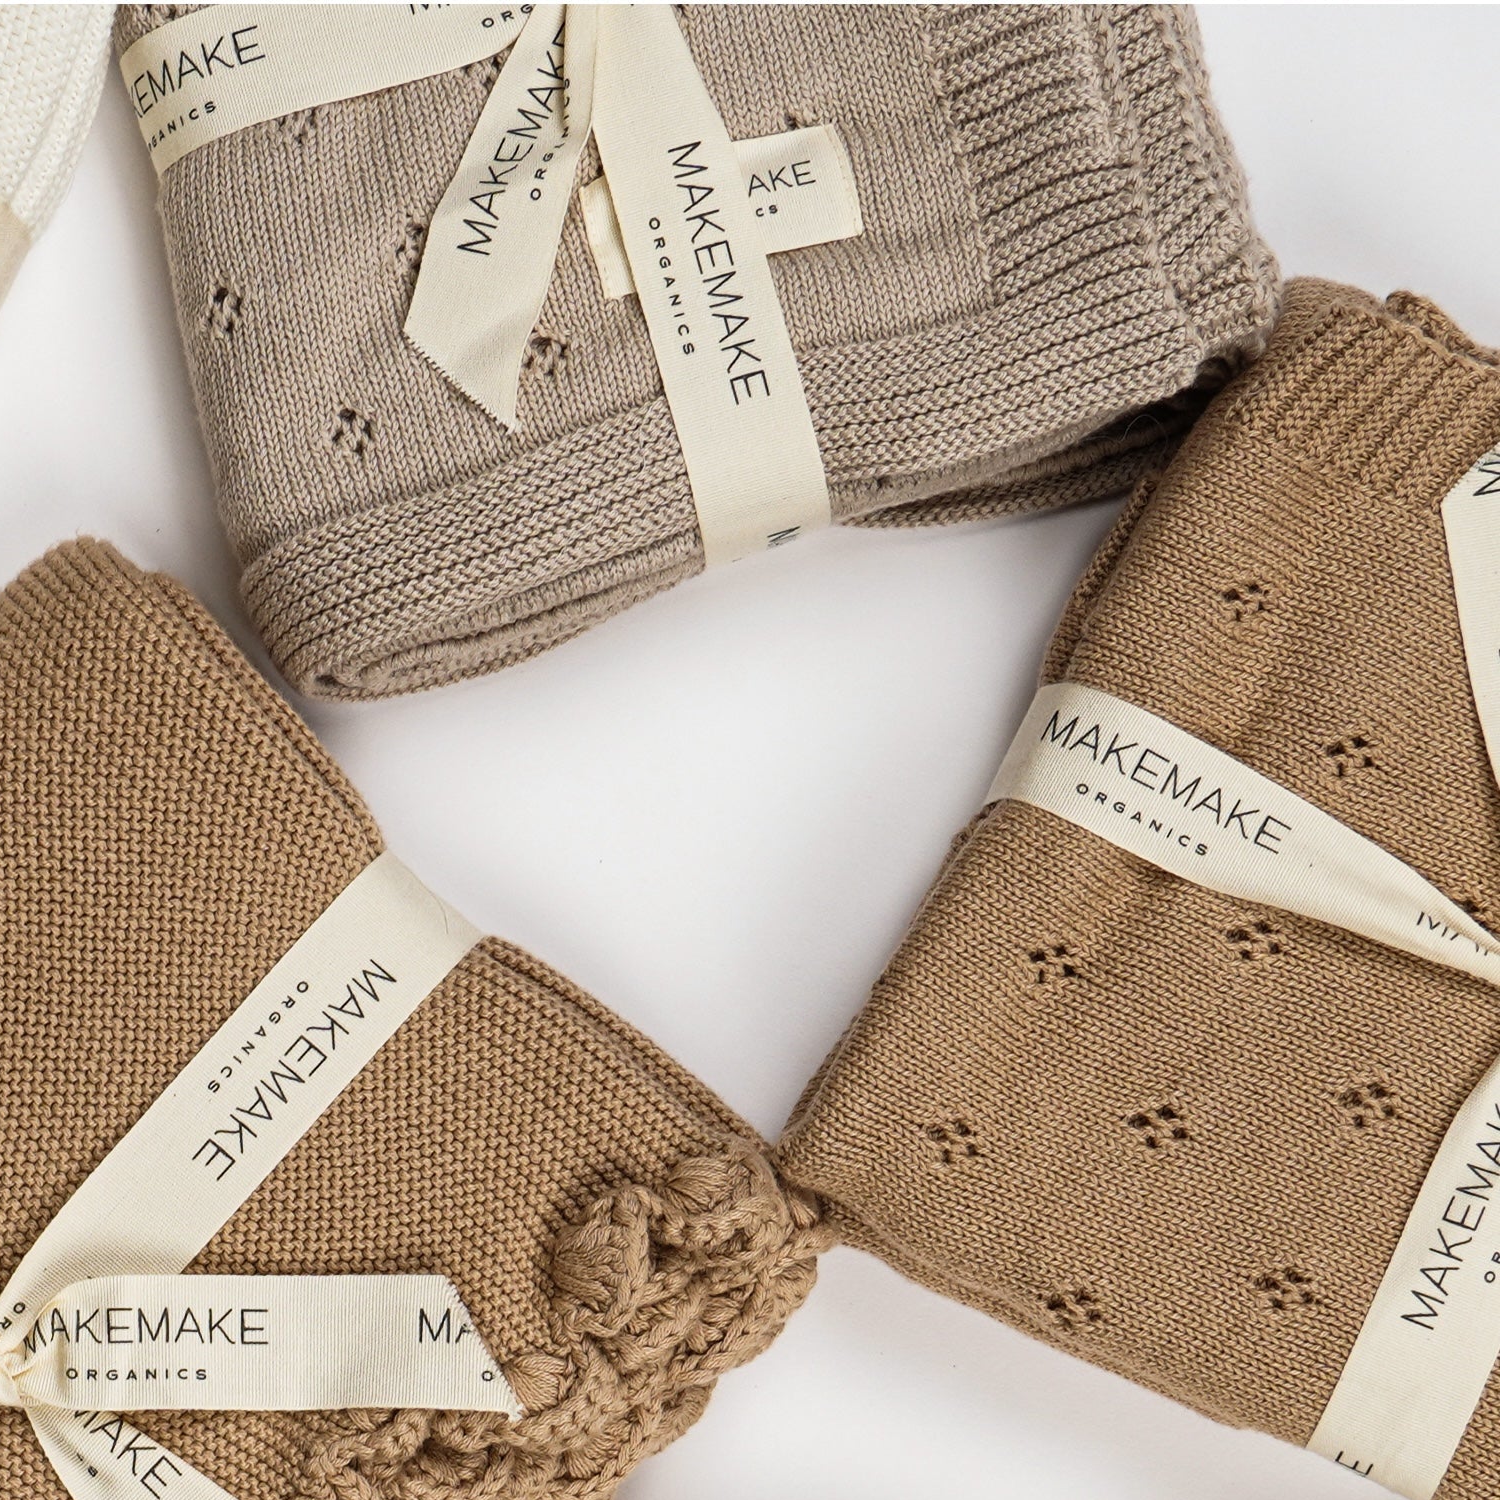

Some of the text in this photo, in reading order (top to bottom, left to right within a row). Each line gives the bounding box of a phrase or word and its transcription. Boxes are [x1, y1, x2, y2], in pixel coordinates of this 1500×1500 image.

[148, 101, 216, 151] GANICS
[648, 217, 694, 355] ORGANICS
[668, 141, 770, 405] MAKEMAKE
[1041, 710, 1292, 854] MAKEMAKE
[1076, 783, 1208, 856] ORGANICS
[192, 959, 396, 1181] MAKEMAKE
[207, 980, 309, 1093] ORGANICS
[66, 1368, 208, 1382] ORGANICS
